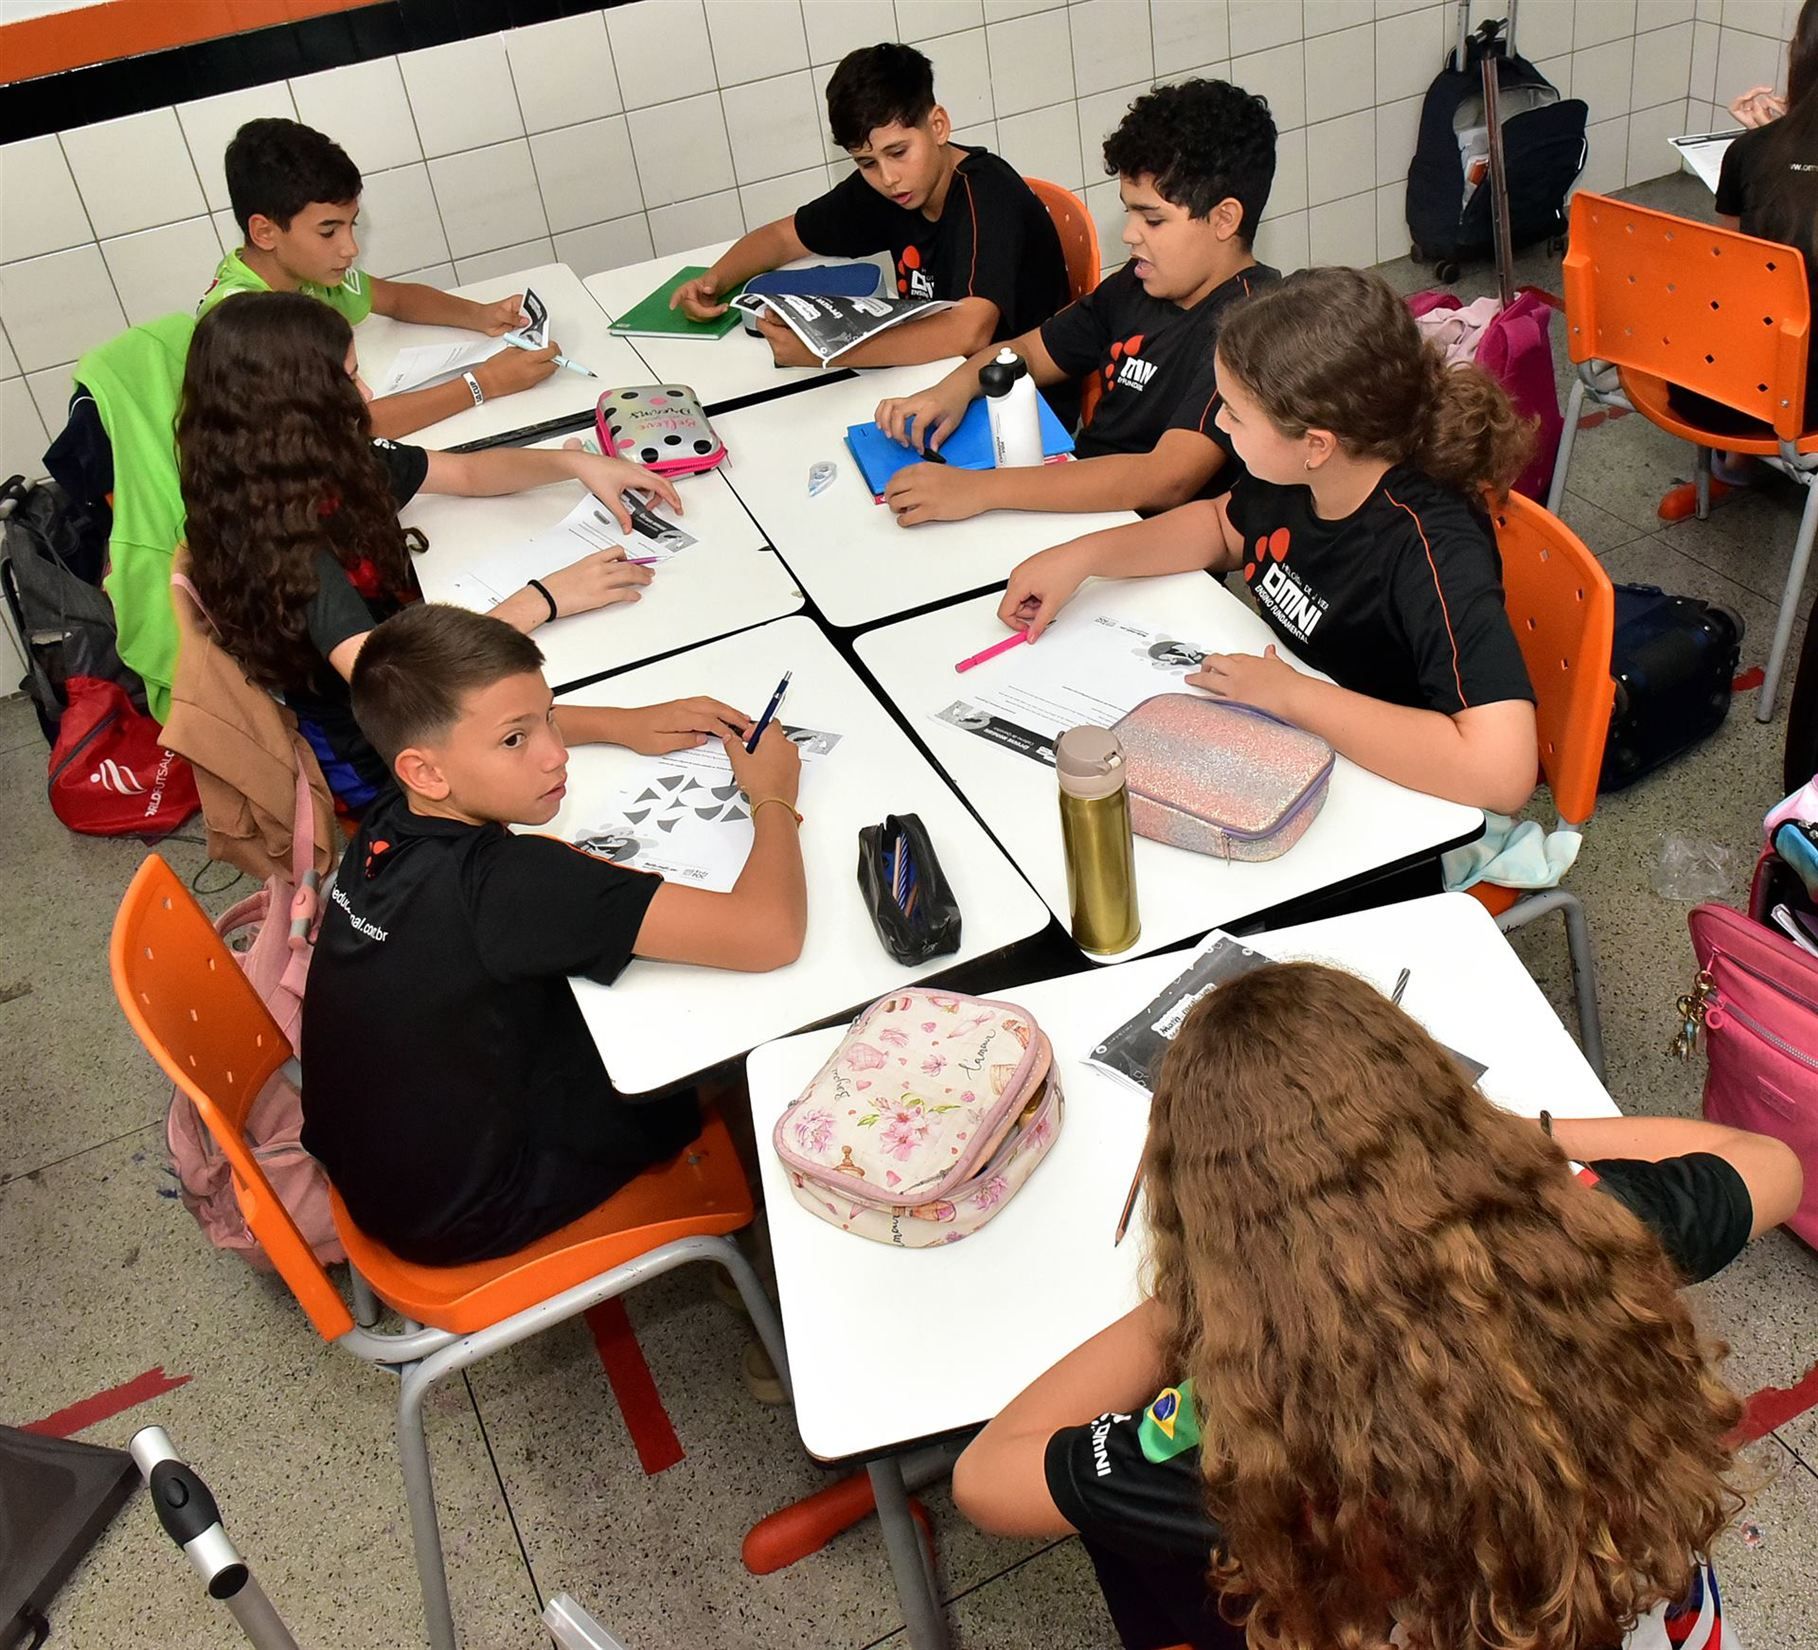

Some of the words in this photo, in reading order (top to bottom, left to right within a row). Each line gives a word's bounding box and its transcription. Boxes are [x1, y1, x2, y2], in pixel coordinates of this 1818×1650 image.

[1254, 583, 1274, 608] ENSINO
[1270, 603, 1309, 645] FUNDAMENTAL
[1261, 562, 1323, 637] OMNI
[1092, 1422, 1112, 1477] OMNI
